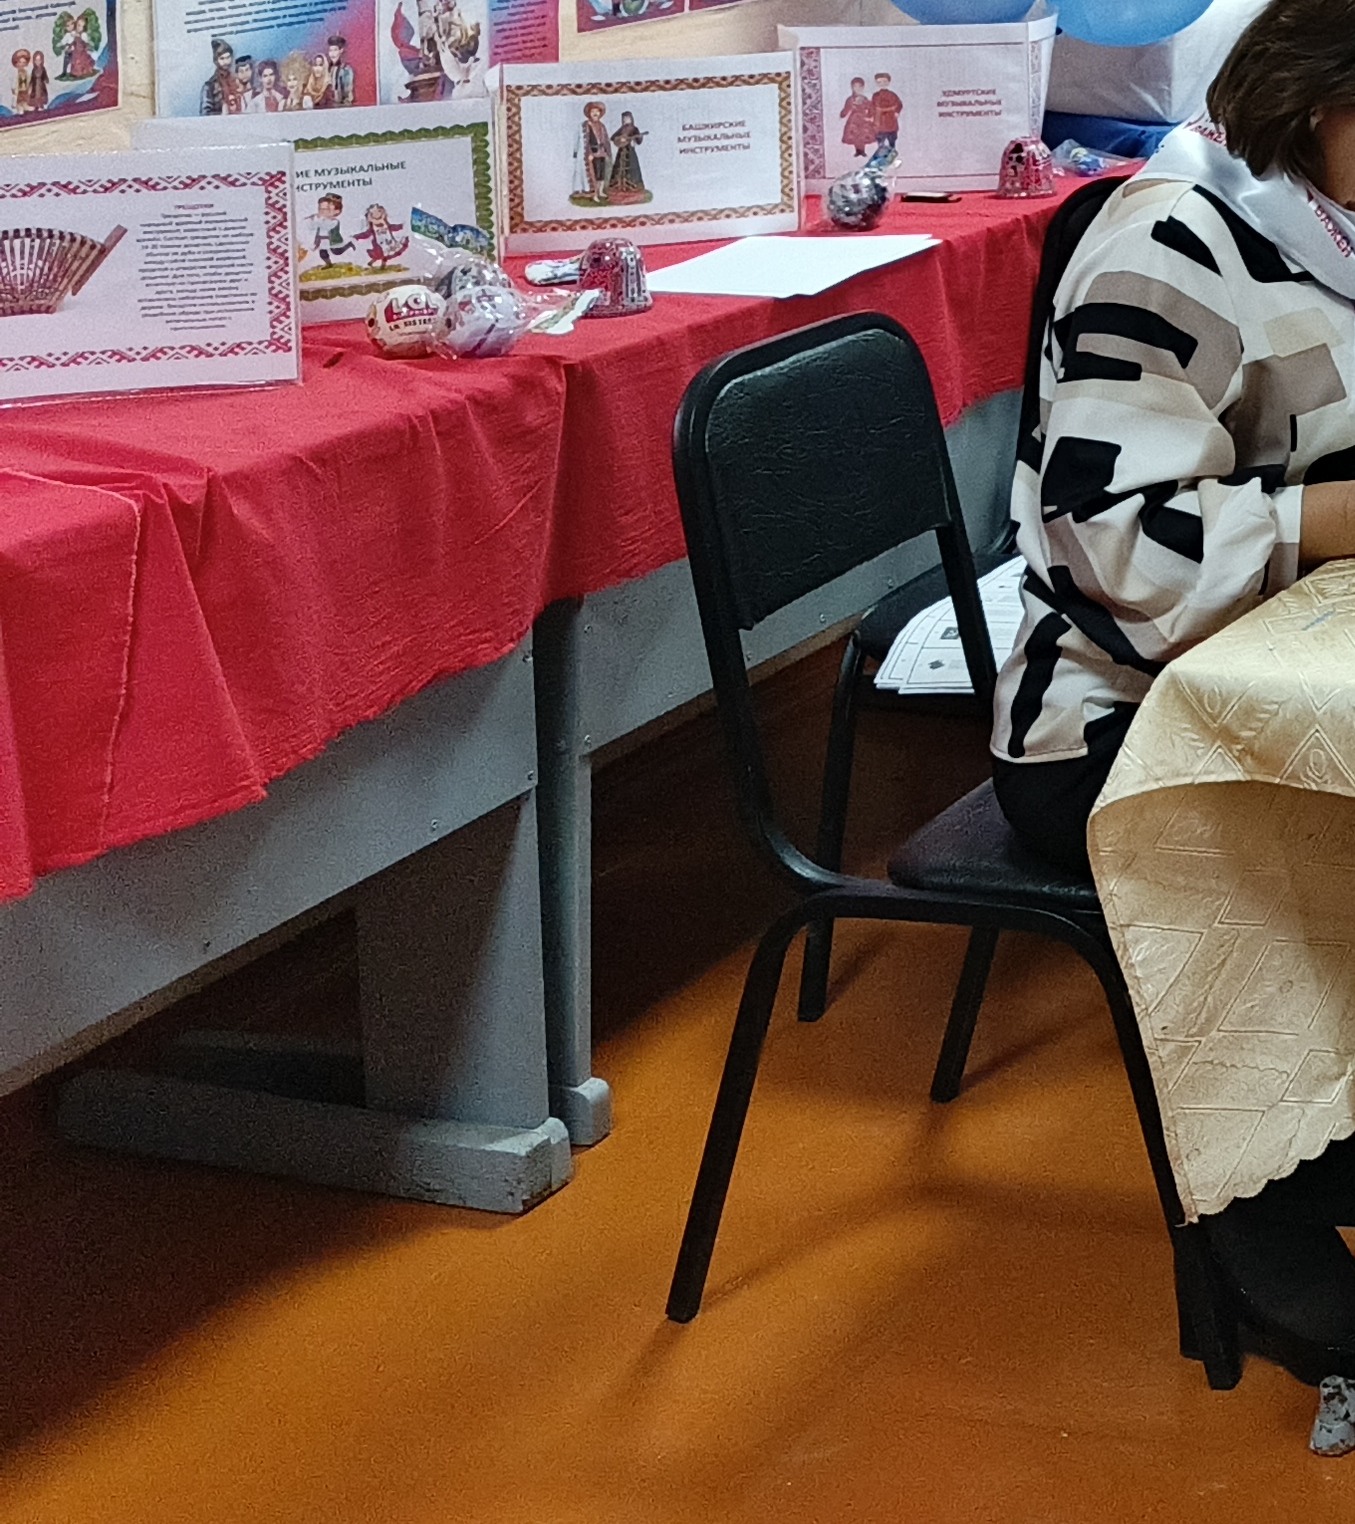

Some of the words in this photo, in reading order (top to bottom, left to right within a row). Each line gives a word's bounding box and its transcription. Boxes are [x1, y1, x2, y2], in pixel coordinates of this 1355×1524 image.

[681, 119, 747, 132] БАШКИРСКИЕ
[679, 143, 751, 155] ИНСТРУМЕНТЫ
[313, 161, 407, 178] МУЗЫКАЛЬНЫЕ
